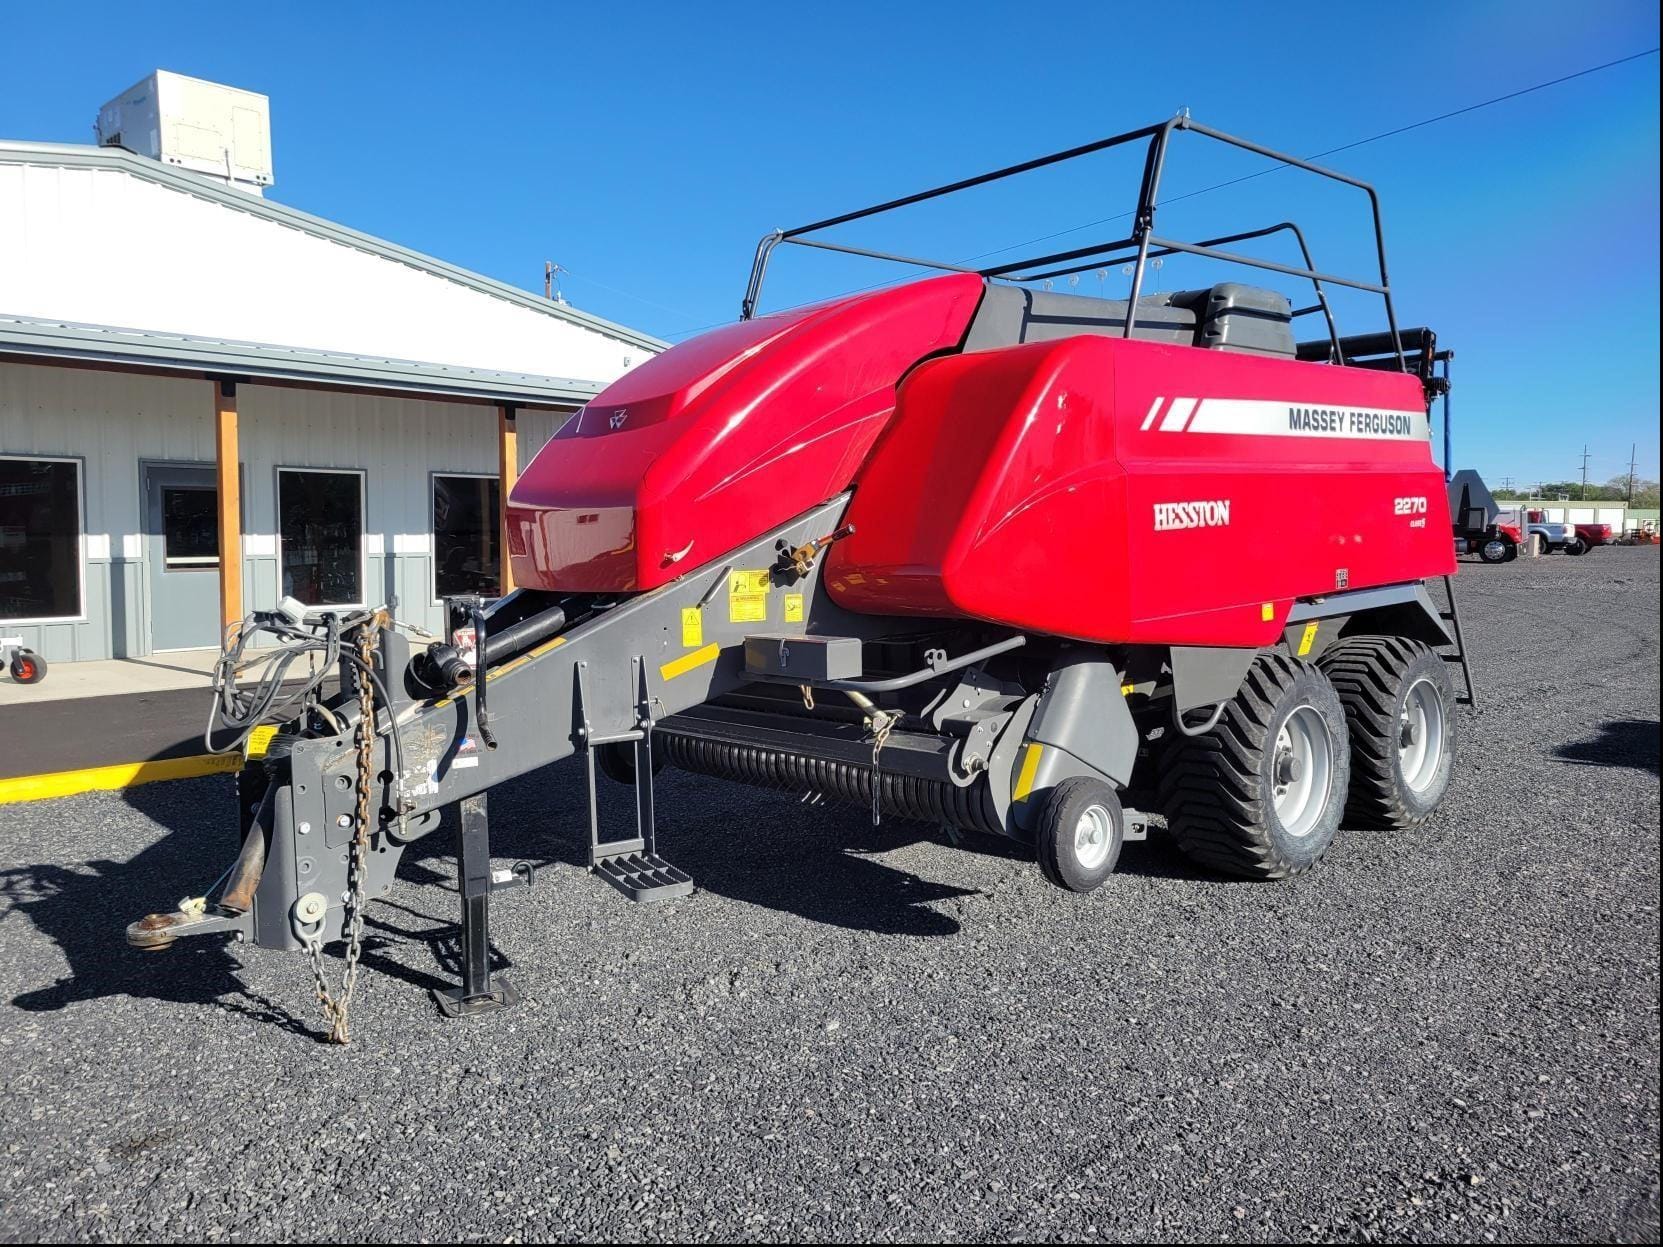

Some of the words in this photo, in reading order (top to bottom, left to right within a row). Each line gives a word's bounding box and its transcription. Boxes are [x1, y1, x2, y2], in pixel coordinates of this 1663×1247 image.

[1289, 407, 1345, 433] MASSEY
[1349, 411, 1412, 436] FERGUSON
[1153, 499, 1231, 532] HESSTON
[1394, 497, 1427, 515] 2270
